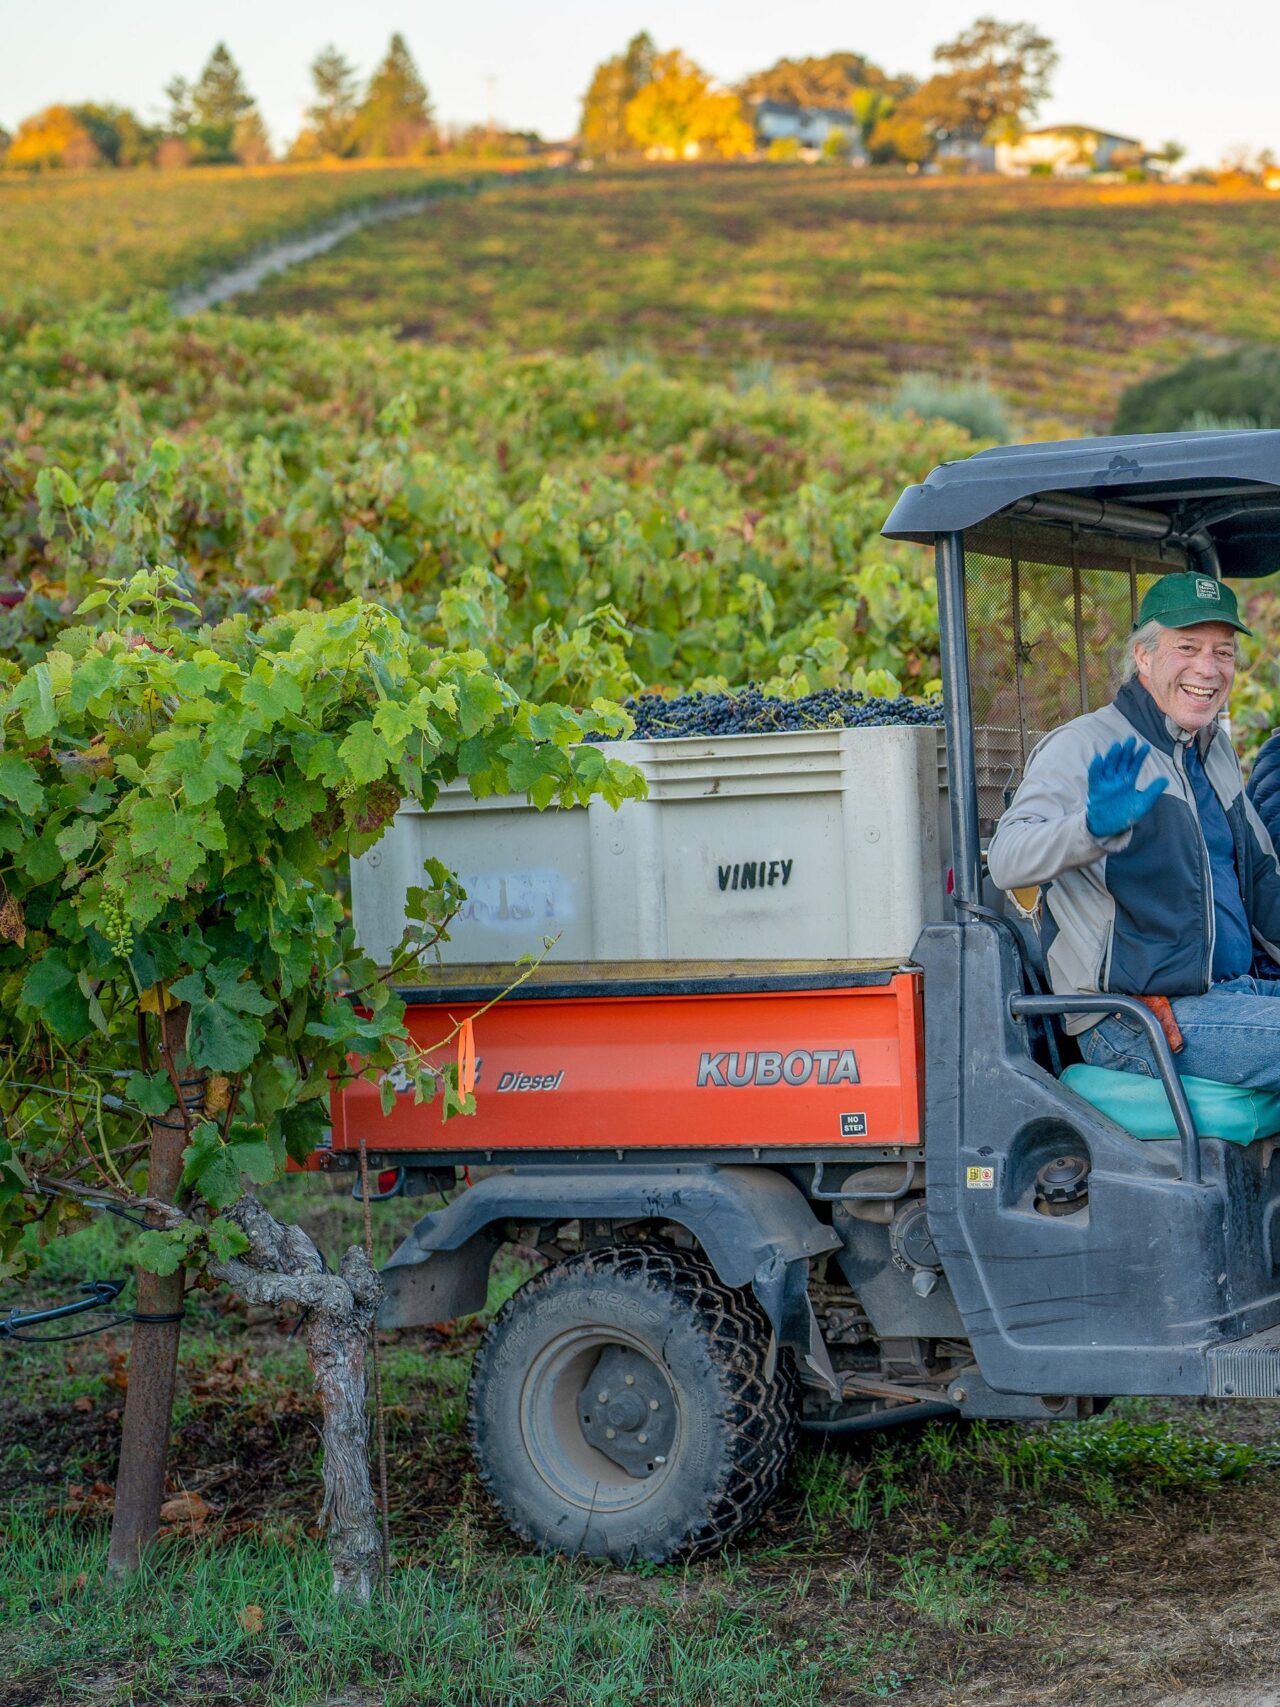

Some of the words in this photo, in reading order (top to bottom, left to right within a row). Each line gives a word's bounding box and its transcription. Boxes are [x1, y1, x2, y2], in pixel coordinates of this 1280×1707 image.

[718, 859, 793, 891] VINIFY
[497, 1069, 565, 1092] Diesel
[696, 1049, 861, 1087] KUBOTA
[844, 1124, 864, 1132] STEP
[588, 1289, 662, 1324] ROAD
